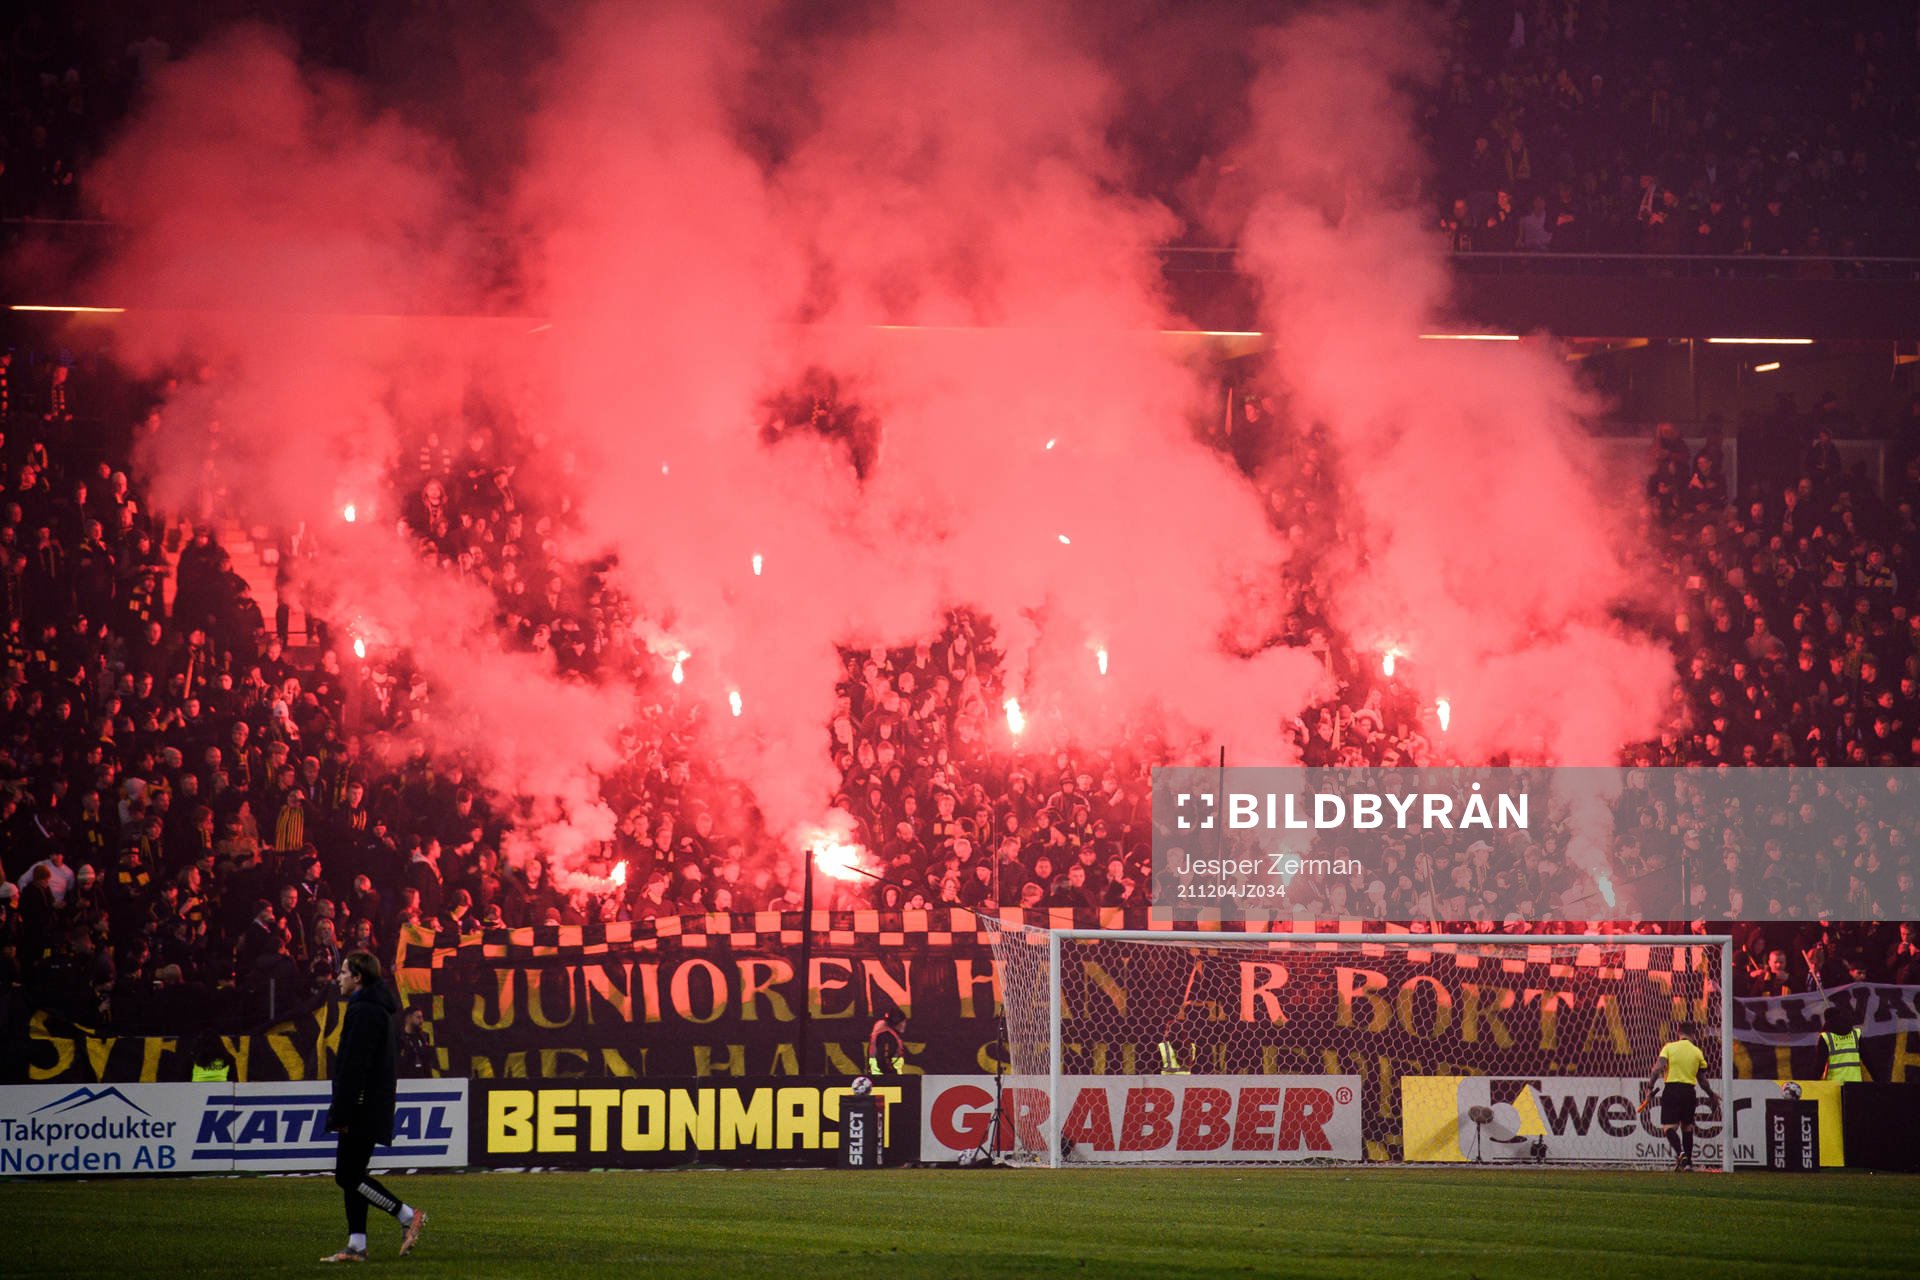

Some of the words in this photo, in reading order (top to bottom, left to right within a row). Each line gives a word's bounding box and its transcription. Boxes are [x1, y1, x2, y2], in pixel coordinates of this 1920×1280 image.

[469, 957, 912, 1030] JUNIOREN
[1, 1116, 177, 1146] Takprodukter
[196, 1106, 454, 1144] KATEAL
[848, 1111, 865, 1166] SELECT
[1773, 1115, 1786, 1169] SELECT
[1801, 1115, 1813, 1169] SELECT
[1, 1145, 122, 1172] Norden
[133, 1145, 177, 1170] AB
